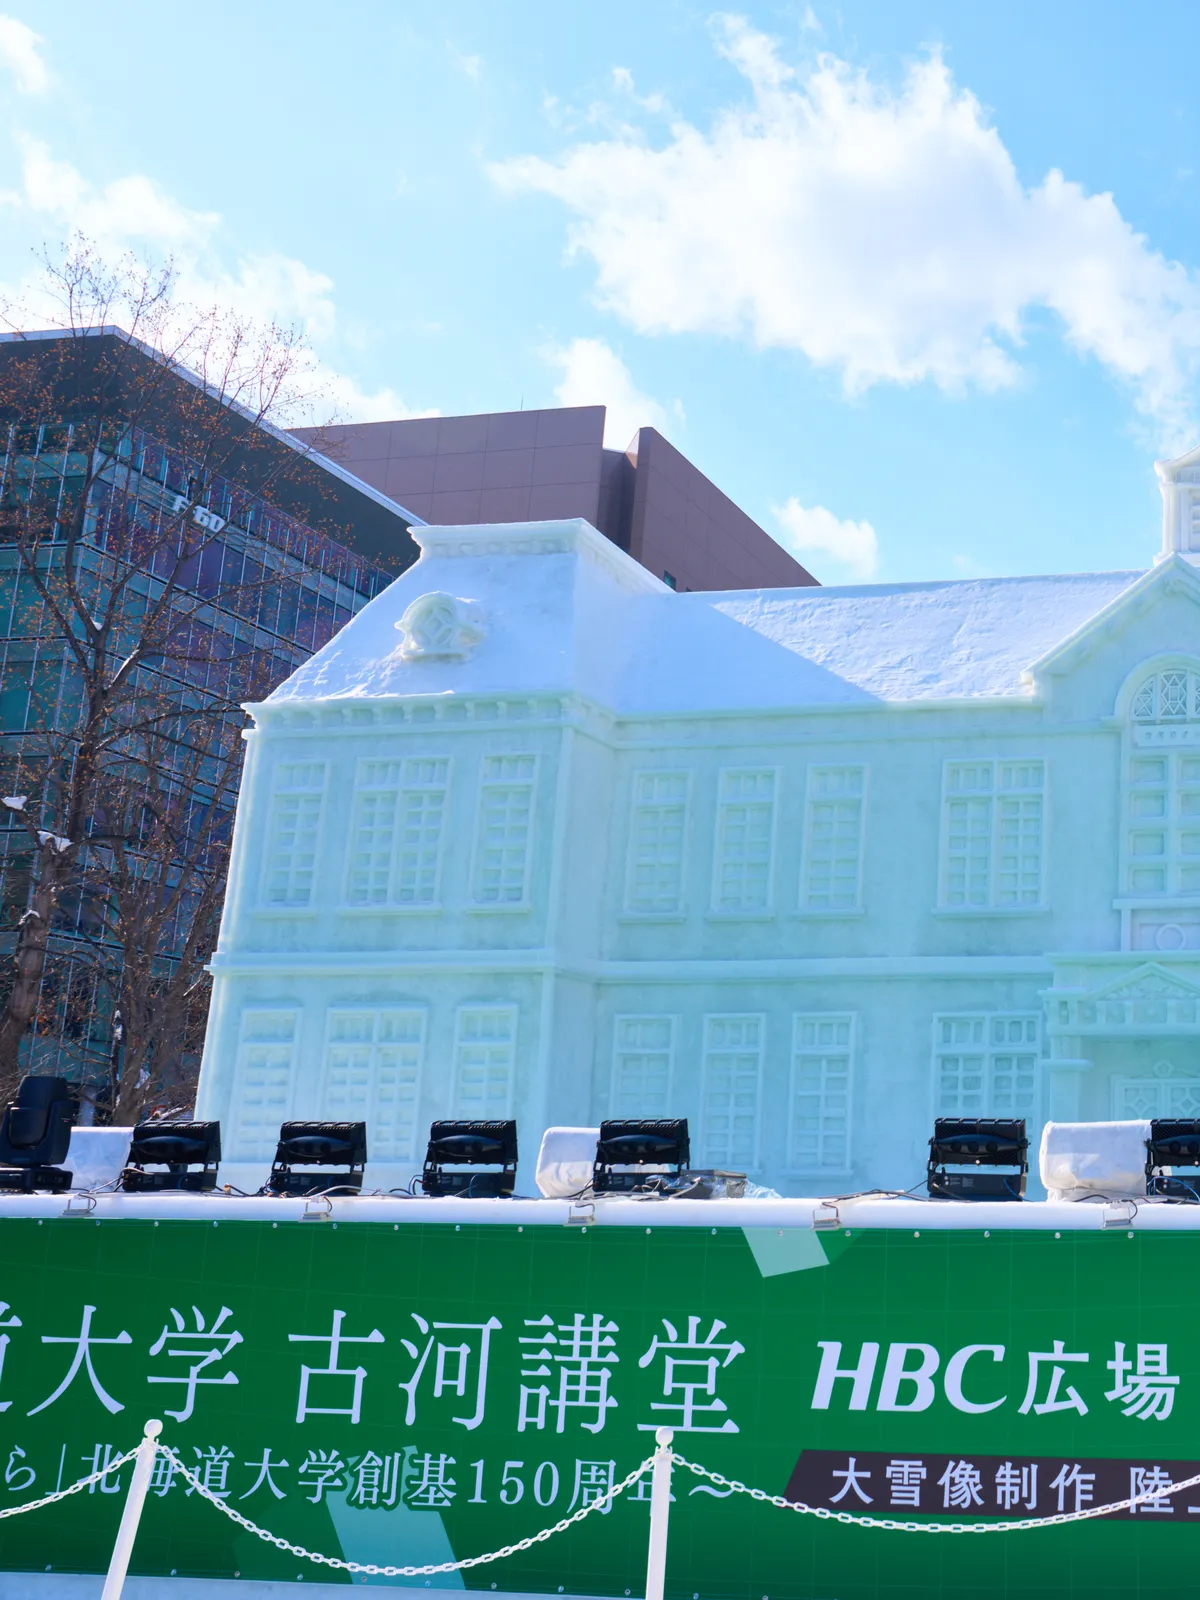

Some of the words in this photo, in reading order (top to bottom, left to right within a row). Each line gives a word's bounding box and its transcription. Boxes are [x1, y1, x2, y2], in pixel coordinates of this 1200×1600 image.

[288, 1310, 746, 1434] 古河講堂
[831, 1456, 1097, 1512] 大雪像制作
